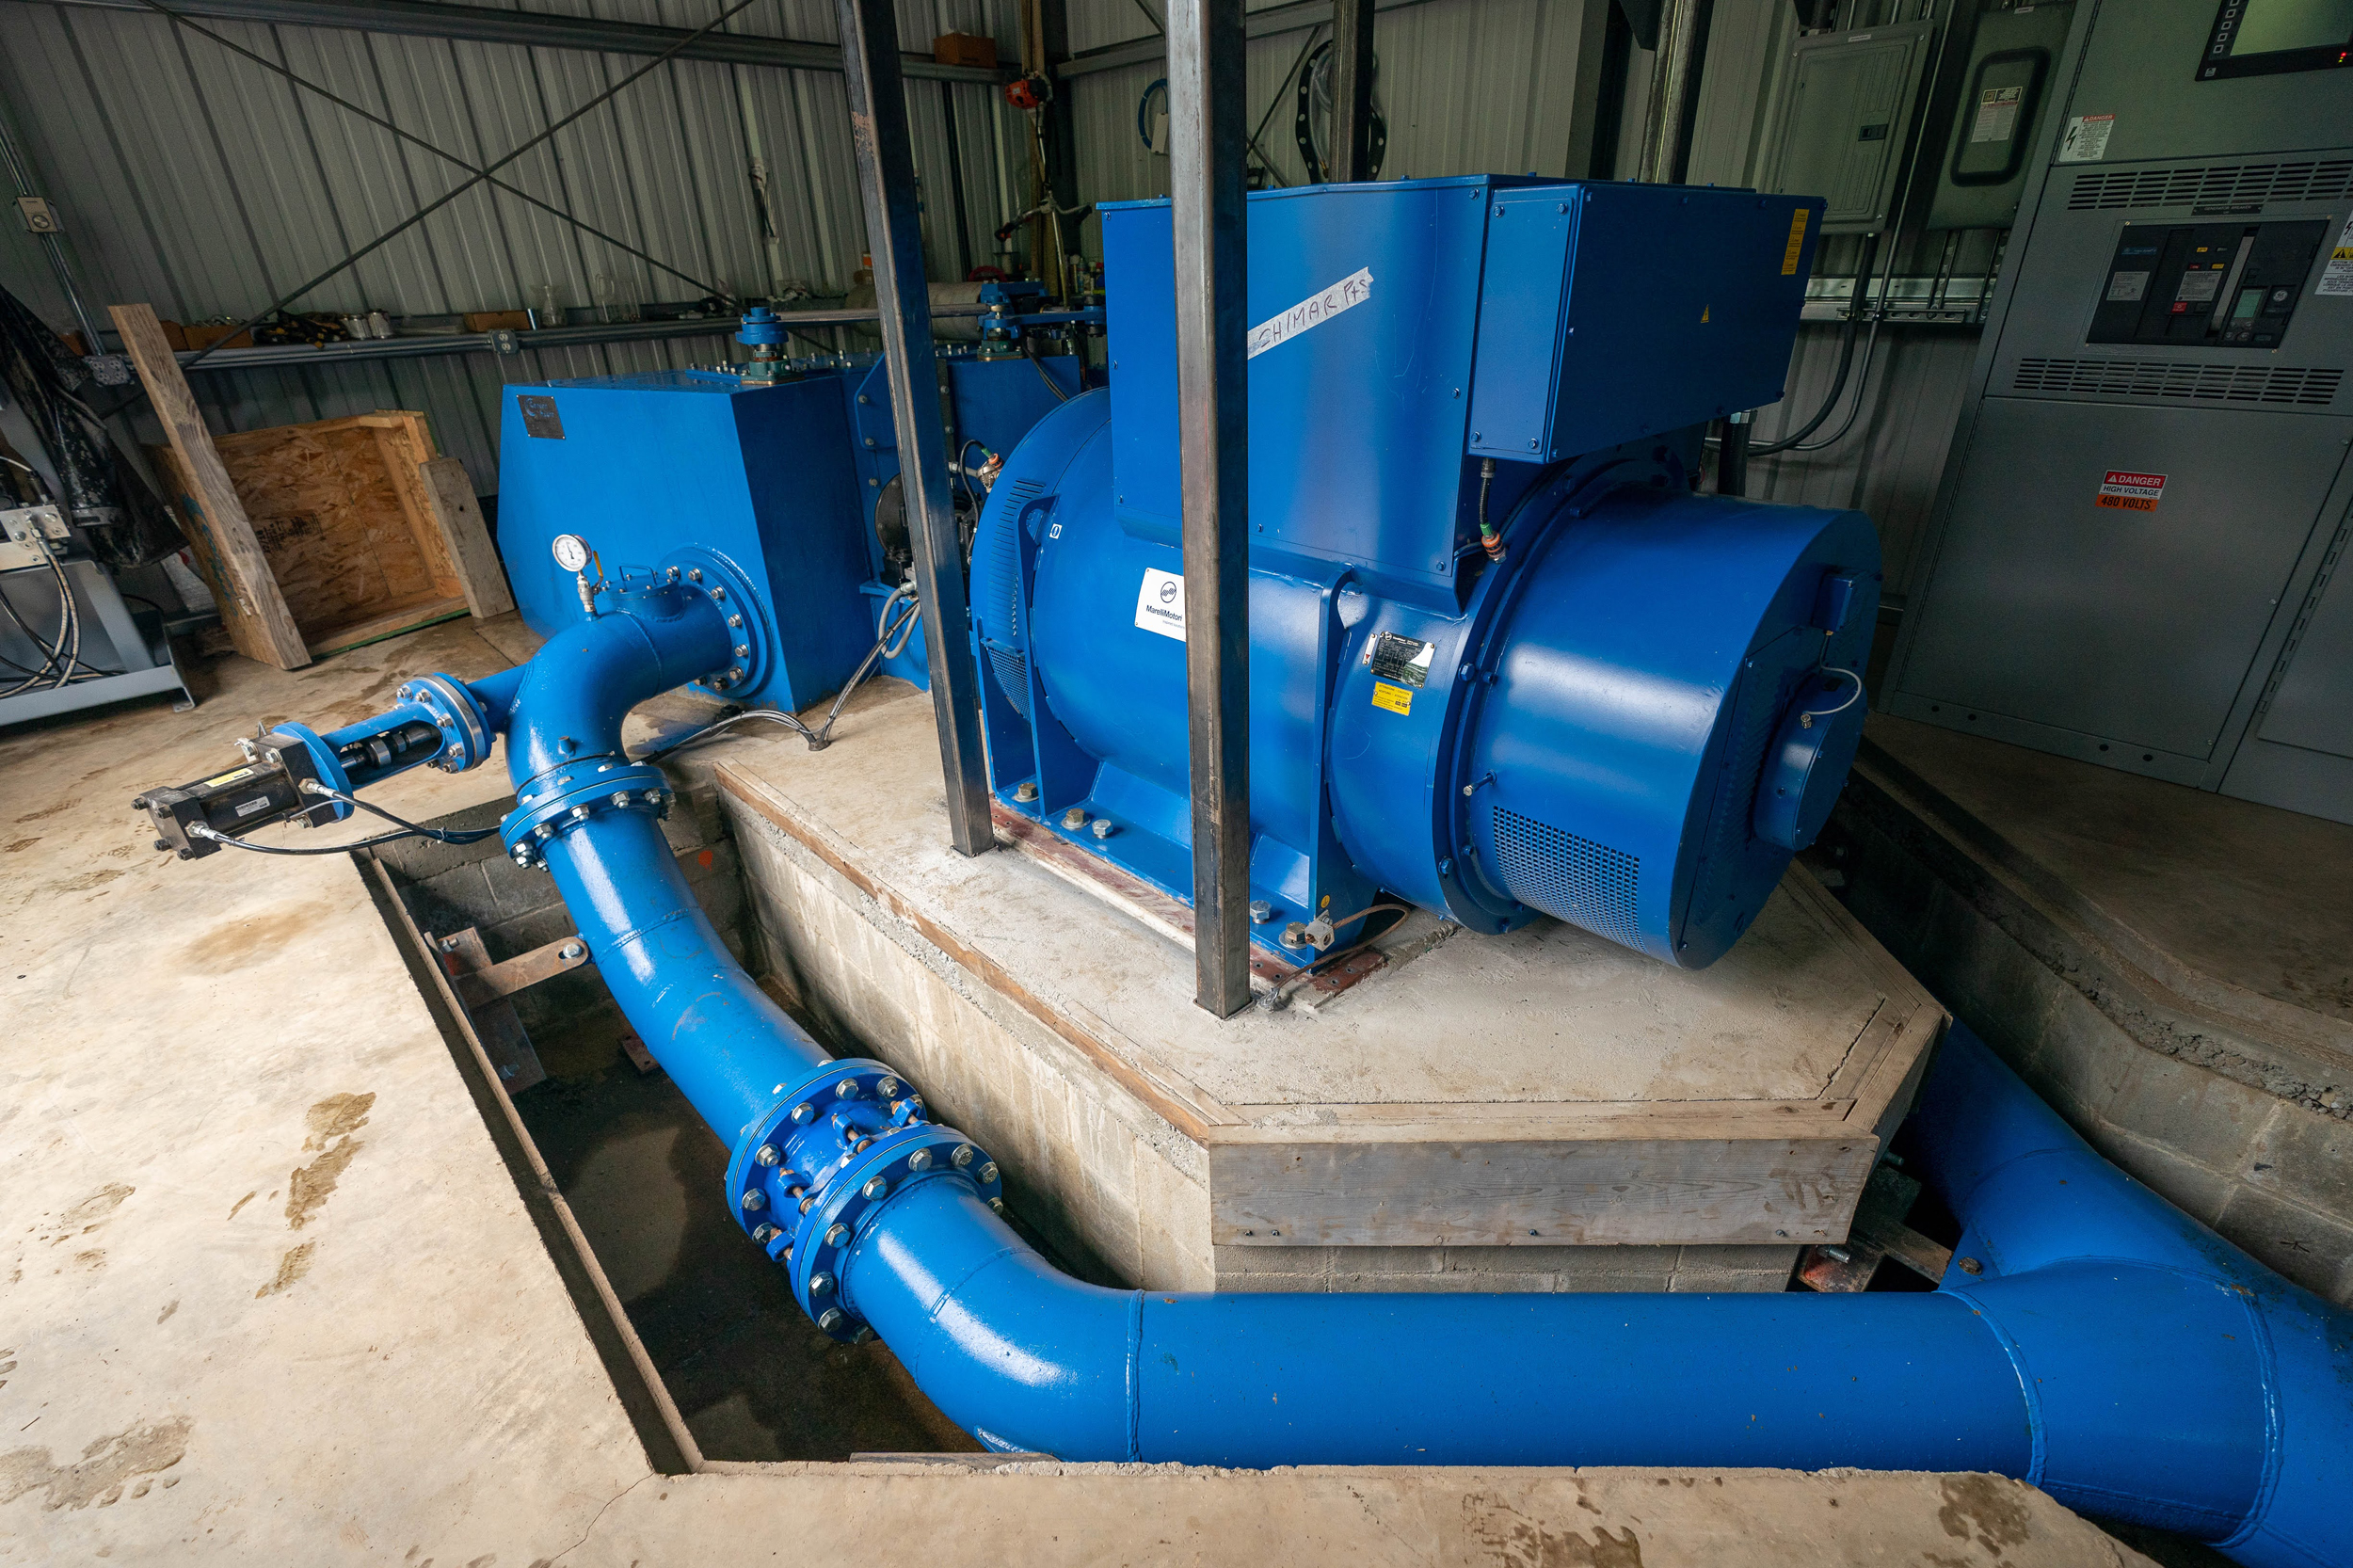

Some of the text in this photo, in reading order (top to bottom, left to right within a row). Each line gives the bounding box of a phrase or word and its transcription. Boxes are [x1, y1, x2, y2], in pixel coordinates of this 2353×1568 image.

[2119, 475, 2161, 486] DANGER
[2124, 488, 2159, 496] VOLTAGE
[2101, 496, 2152, 509] 480 VOLTS
[1145, 604, 1182, 621] MarelliMotori
